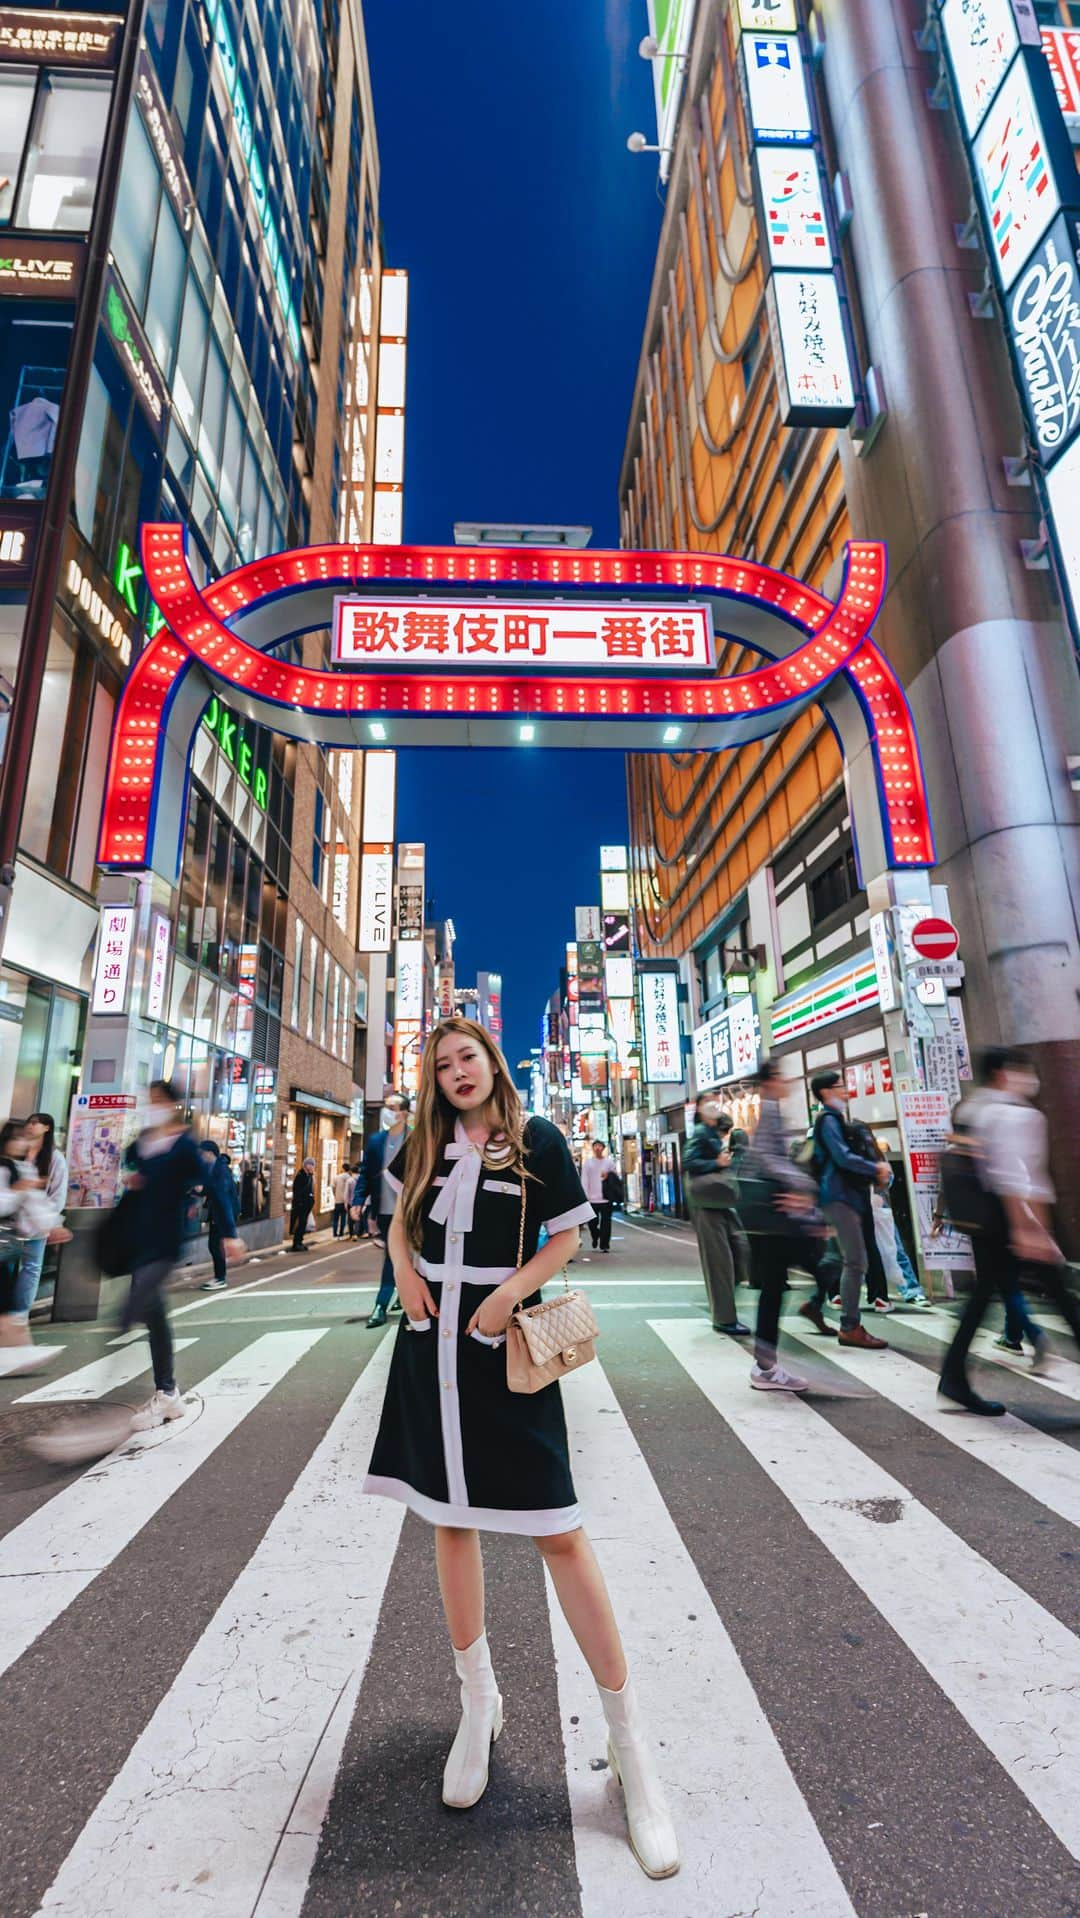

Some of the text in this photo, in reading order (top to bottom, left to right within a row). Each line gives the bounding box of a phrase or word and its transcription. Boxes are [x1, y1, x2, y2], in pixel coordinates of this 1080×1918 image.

[799, 281, 826, 369] お好み焼き
[67, 559, 132, 666] DOUTOR
[352, 611, 695, 658] 歌舞伎町一番街
[383, 845, 391, 854] 3
[103, 915, 127, 1004] 劇場通り
[653, 976, 668, 1036] お好み焼き
